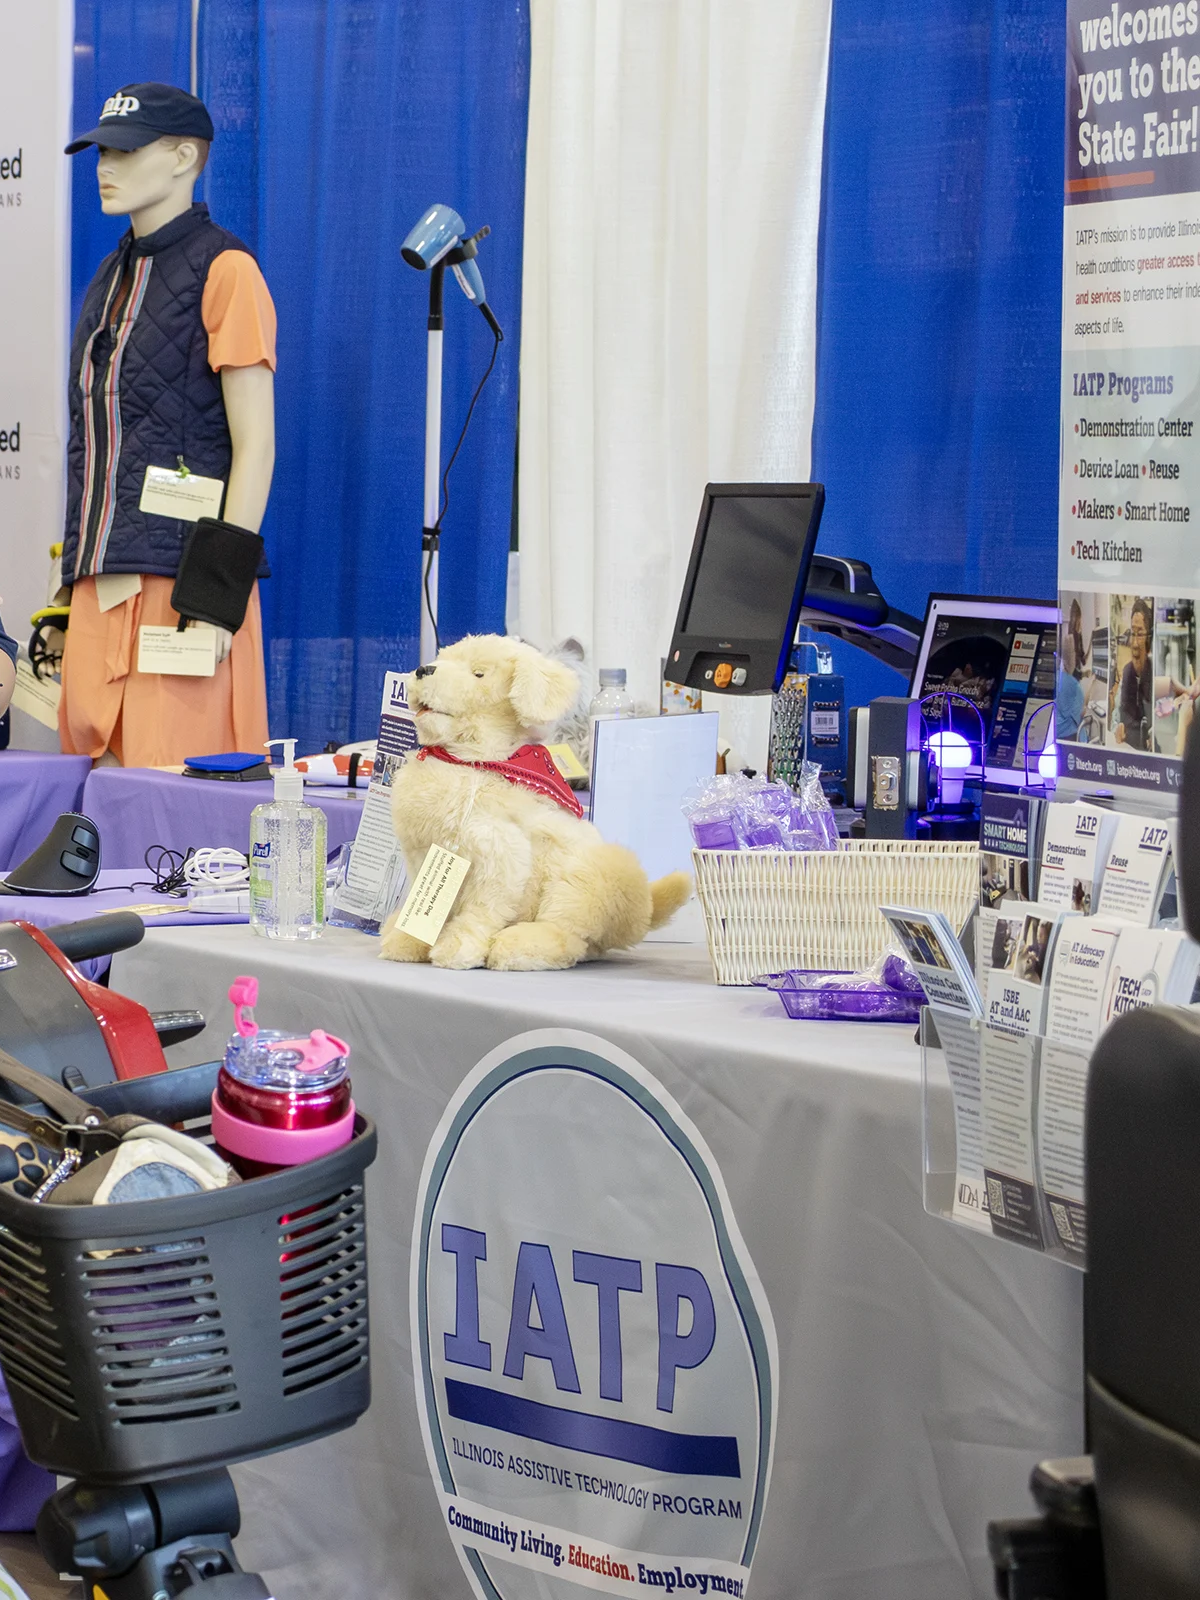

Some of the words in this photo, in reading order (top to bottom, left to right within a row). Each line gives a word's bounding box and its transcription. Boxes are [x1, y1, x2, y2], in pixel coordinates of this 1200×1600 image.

[1080, 0, 1199, 53] welcomes
[1078, 68, 1123, 119] you
[1129, 57, 1154, 99] to
[1161, 46, 1200, 94] the
[1078, 121, 1136, 167] State
[1143, 105, 1198, 159] Fair!
[1075, 229, 1099, 246] IATP's
[1100, 226, 1128, 243] mission
[1130, 225, 1136, 241] is
[1139, 225, 1146, 240] to
[1148, 221, 1176, 242] provide
[1075, 260, 1097, 276] health
[1098, 256, 1135, 274] conditions
[1137, 255, 1165, 275] greater
[1167, 254, 1195, 268] access
[1075, 290, 1089, 305] and
[1090, 287, 1121, 305] services
[1124, 288, 1131, 302] to
[1132, 286, 1165, 302] enhance
[1166, 283, 1184, 299] their
[1074, 320, 1102, 338] aspects
[1103, 317, 1110, 333] of
[1111, 317, 1125, 333] life.
[1073, 373, 1105, 397] IATP
[1108, 372, 1174, 403] Programs
[1080, 416, 1155, 437] Demonstration
[1158, 417, 1193, 437] Center
[1079, 458, 1113, 478] Device
[1114, 459, 1139, 479] Loan
[1149, 460, 1180, 480] Reuse
[1077, 498, 1115, 520] Makers
[1124, 501, 1157, 521] Smart
[1159, 502, 1190, 523] Home
[1076, 539, 1100, 560] Tech
[1102, 540, 1142, 562] Kitchen
[984, 822, 1006, 840] SMART
[1007, 827, 1027, 843] HOME
[1076, 815, 1098, 831] IATP
[1140, 826, 1168, 845] IATP
[1046, 854, 1064, 866] Center
[1047, 842, 1086, 857] Demonstration
[1110, 855, 1128, 867] Reuse
[430, 882, 444, 906] Therapy
[1074, 955, 1100, 969] Education
[1080, 944, 1106, 960] Advocacy
[925, 985, 969, 1006] Connections
[944, 978, 963, 992] Care
[1118, 976, 1142, 997] TECH
[1003, 988, 1020, 1005] ISBE
[990, 1001, 1000, 1015] AT
[1000, 1005, 1014, 1020] and
[1014, 1008, 1031, 1023] AAC
[441, 1223, 717, 1413] IATP
[452, 1437, 504, 1470] ILLINOIS
[507, 1454, 573, 1489] ASSISTIVE
[575, 1472, 649, 1509] TECHNOLOGY
[652, 1493, 742, 1520] PROGRAM
[448, 1505, 517, 1552] Community
[520, 1530, 565, 1567] Living.
[568, 1544, 635, 1582] Education.
